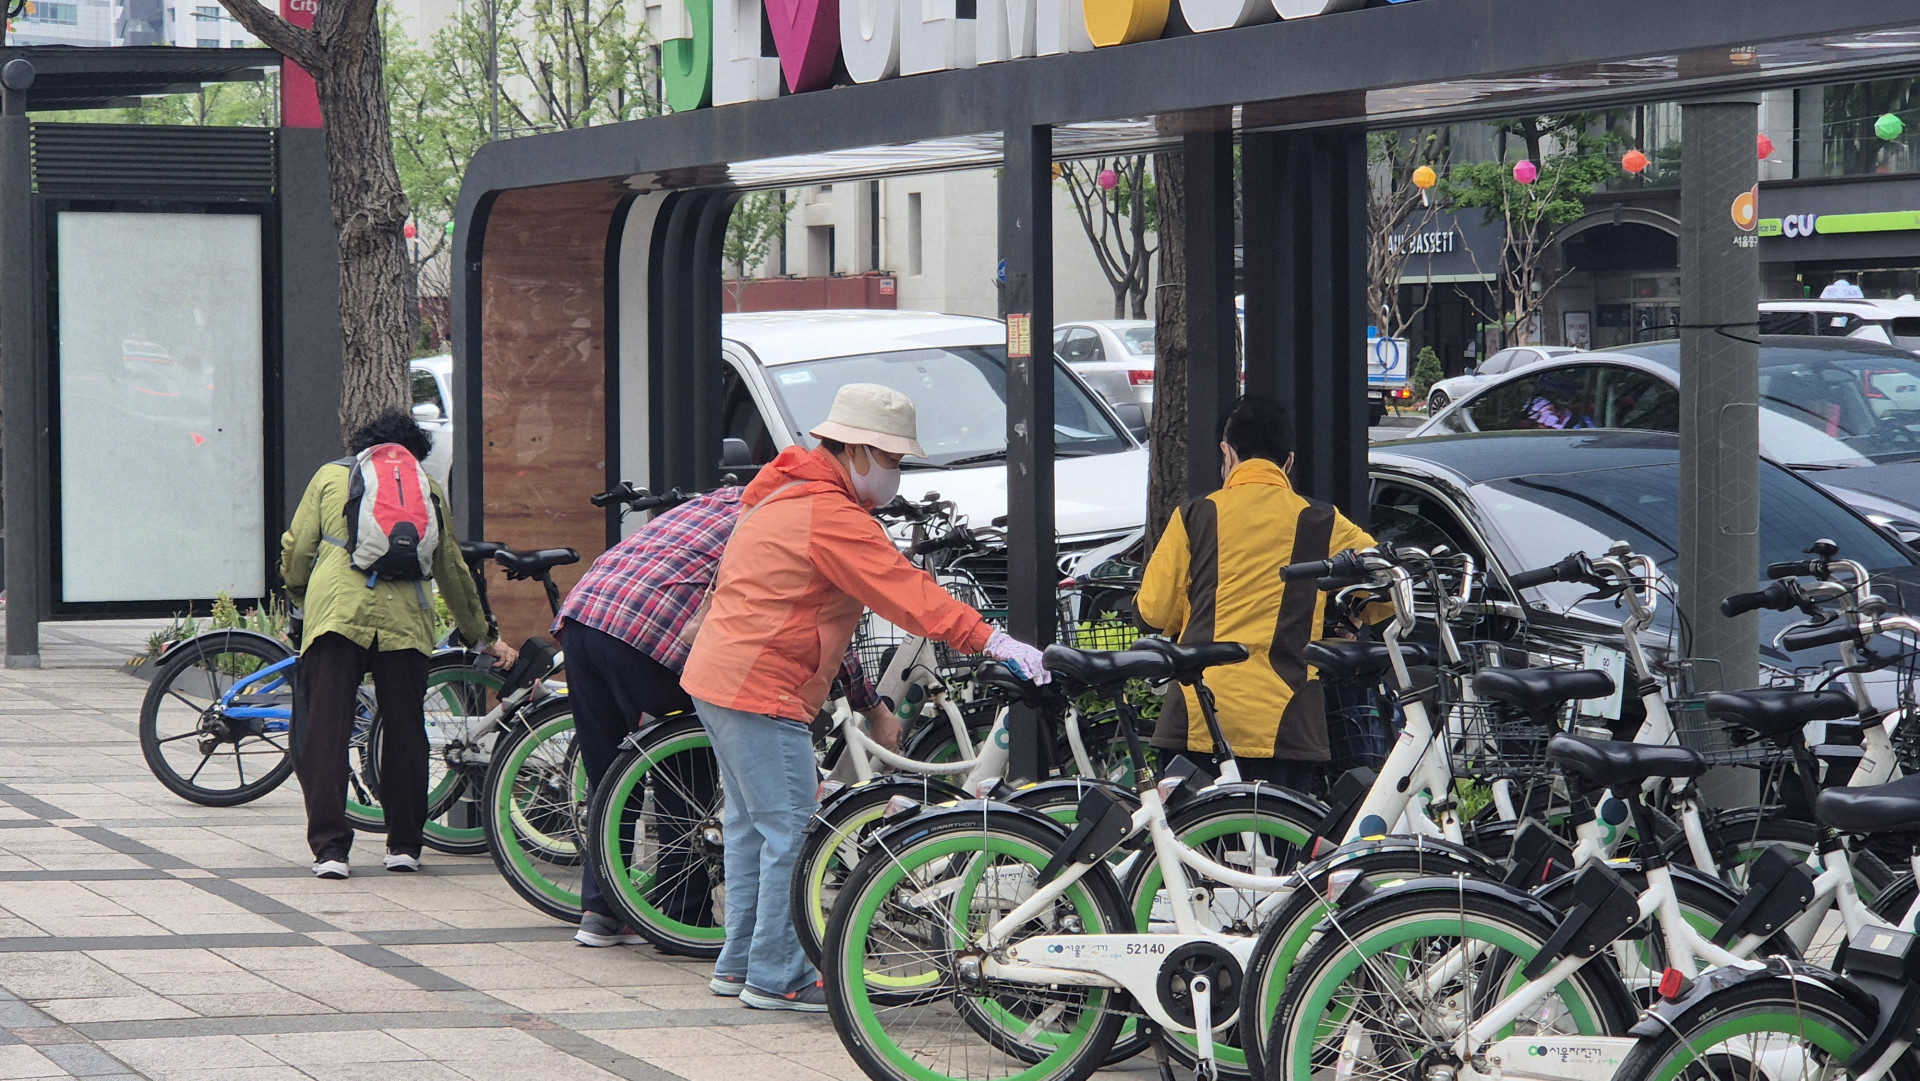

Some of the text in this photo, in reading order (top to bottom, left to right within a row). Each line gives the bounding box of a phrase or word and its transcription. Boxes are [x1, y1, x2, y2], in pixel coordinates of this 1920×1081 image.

[1783, 213, 1815, 239] CU
[1409, 231, 1454, 254] BASSETT
[930, 821, 976, 833] MARATHON
[1126, 943, 1165, 955] 52140
